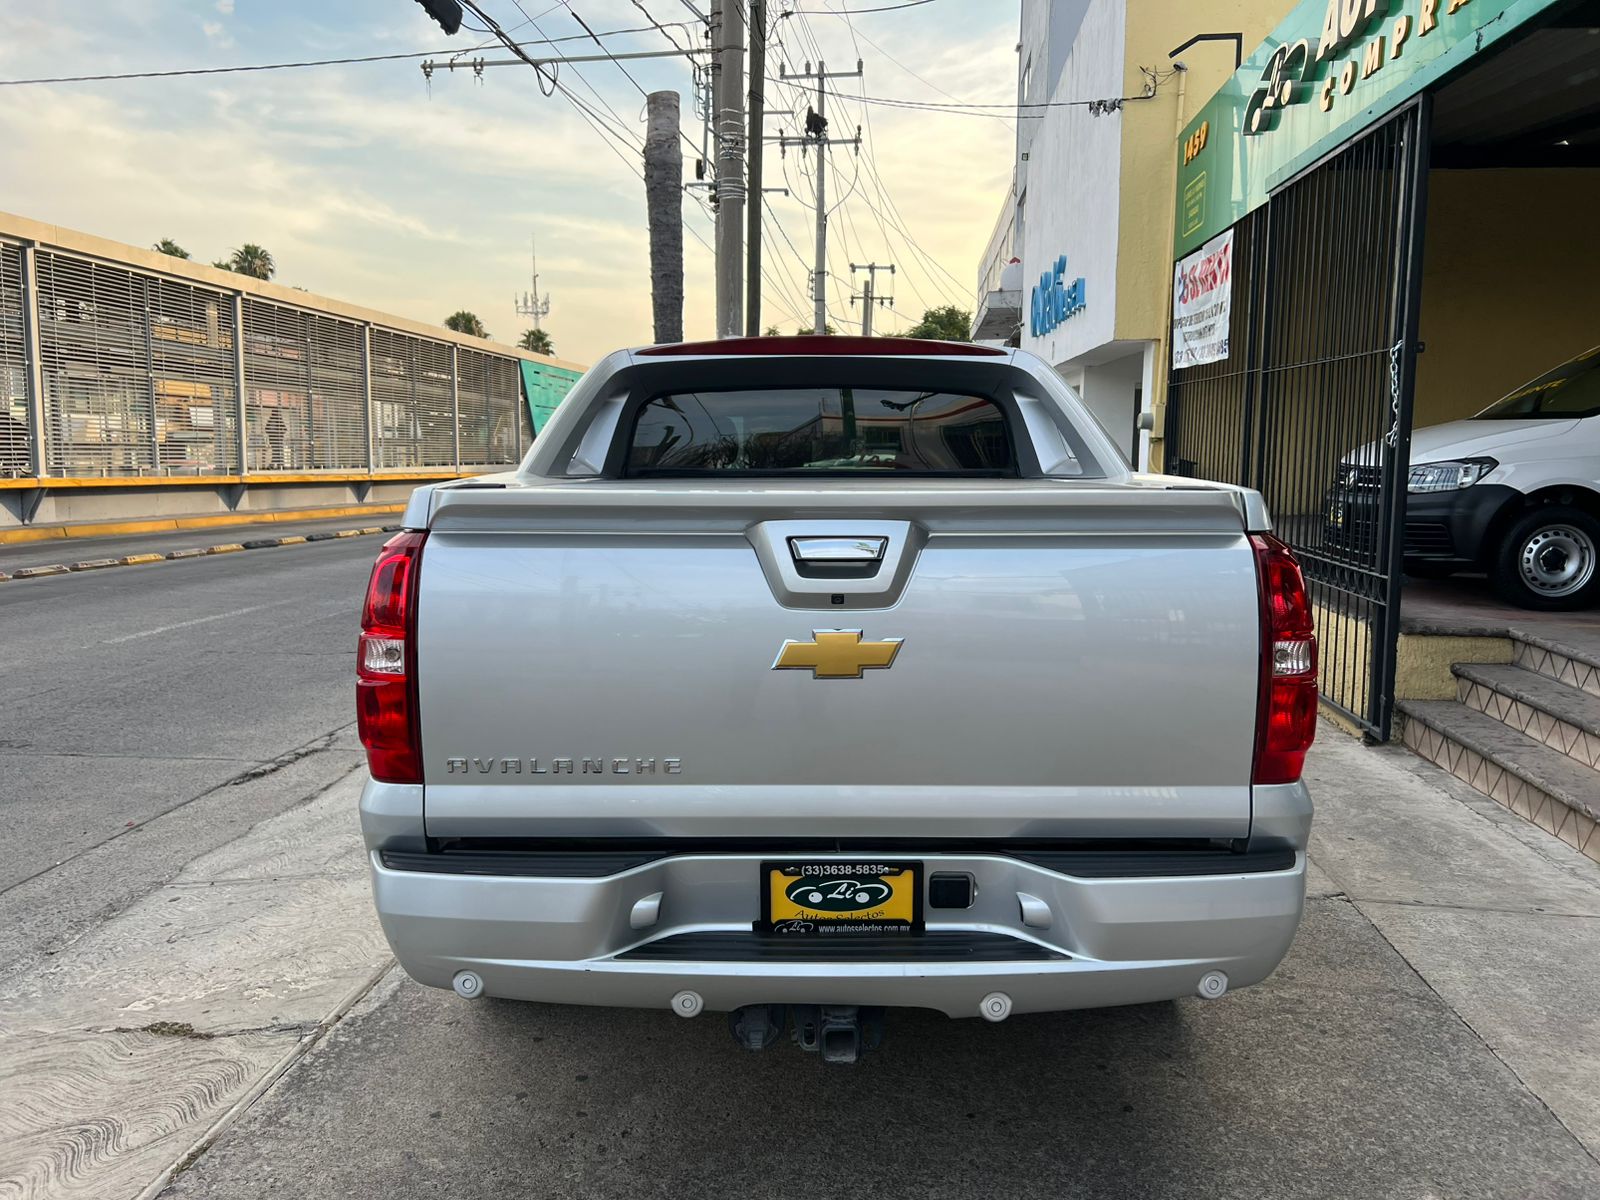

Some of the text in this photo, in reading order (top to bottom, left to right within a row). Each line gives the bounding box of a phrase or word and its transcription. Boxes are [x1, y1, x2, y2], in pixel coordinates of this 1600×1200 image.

[1315, 0, 1377, 62] AU
[1184, 120, 1209, 166] 1459
[447, 757, 682, 775] AVALANCHE
[801, 865, 884, 877] (33)3638-5835
[827, 883, 853, 899] Li
